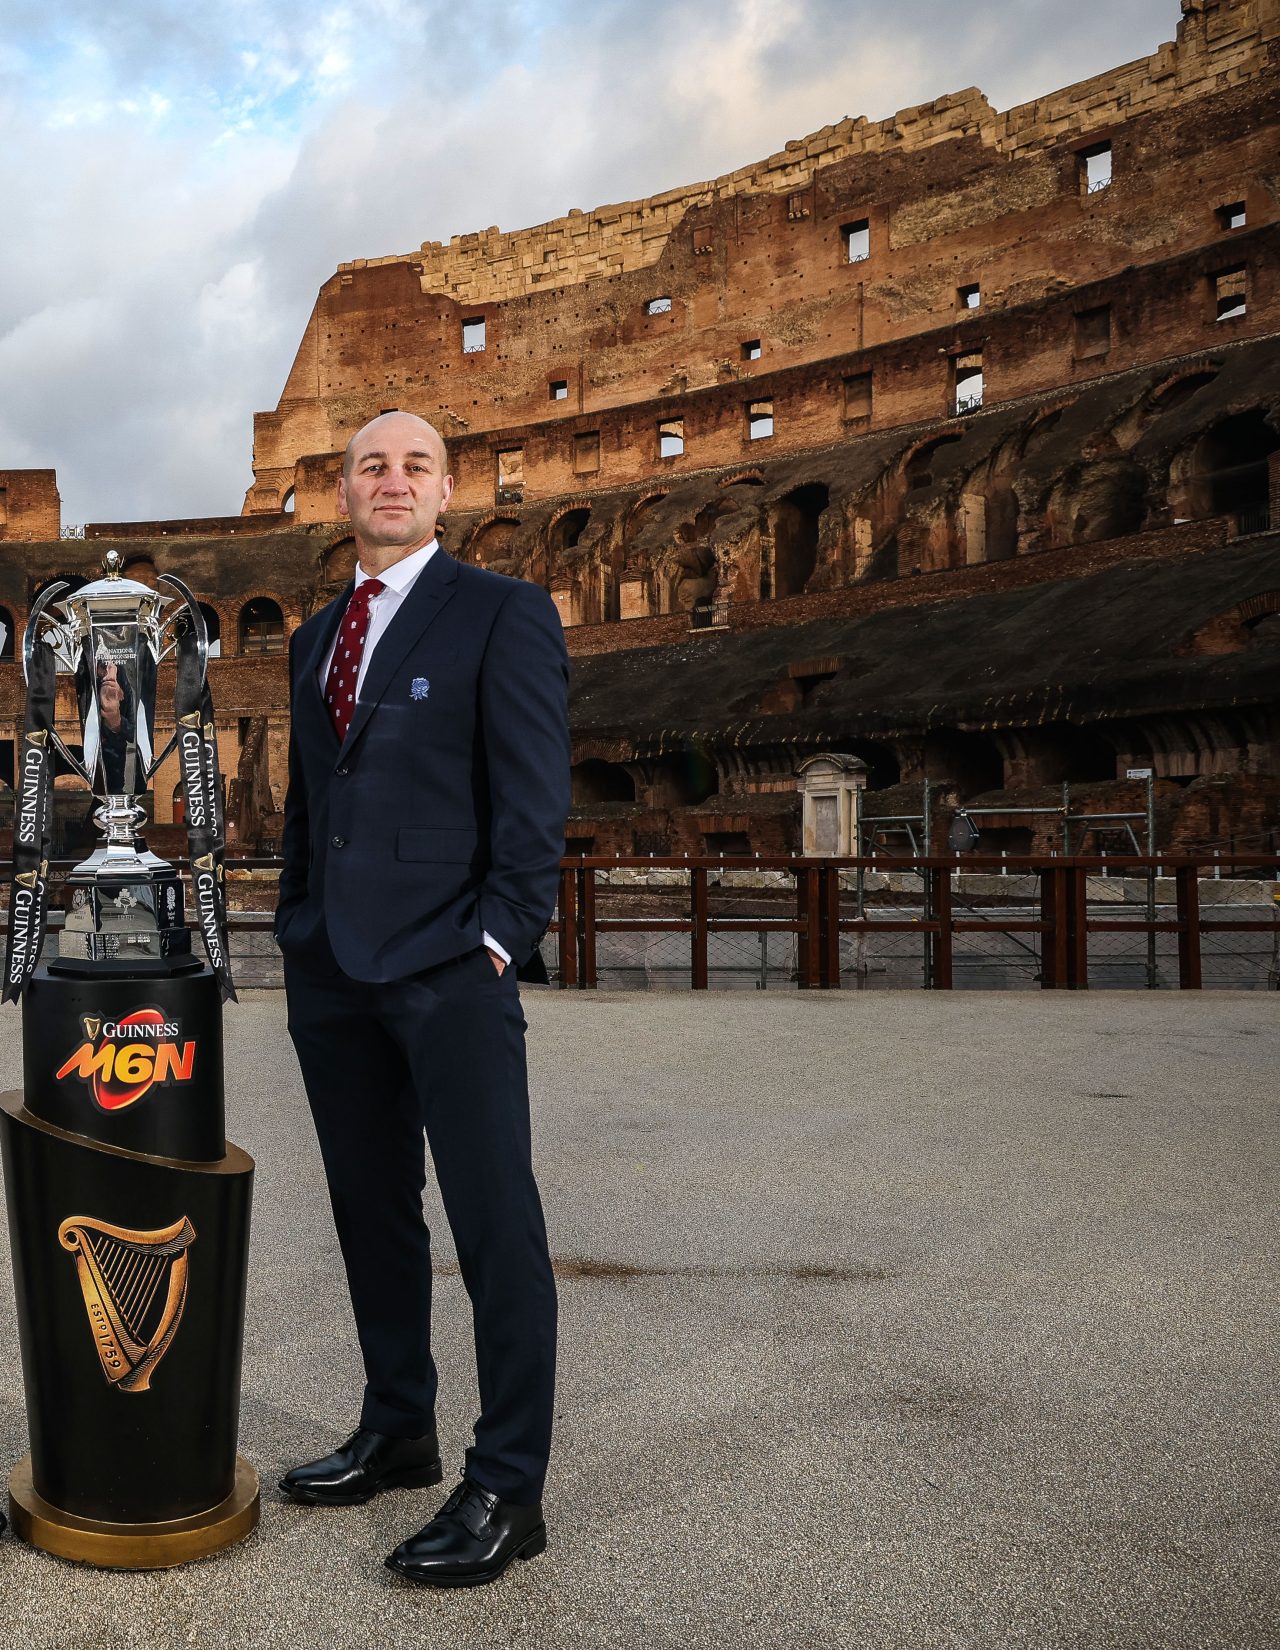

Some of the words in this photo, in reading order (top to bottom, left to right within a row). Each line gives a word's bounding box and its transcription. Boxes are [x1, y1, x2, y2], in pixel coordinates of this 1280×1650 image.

[19, 748, 44, 843] GUINNESS
[182, 731, 205, 827] GUINNESS
[9, 888, 34, 984] GUINNESS
[197, 872, 223, 968] GUINNESS
[55, 1040, 196, 1084] M6N
[102, 1021, 179, 1038] GUINNESS
[99, 1333, 121, 1368] 1759
